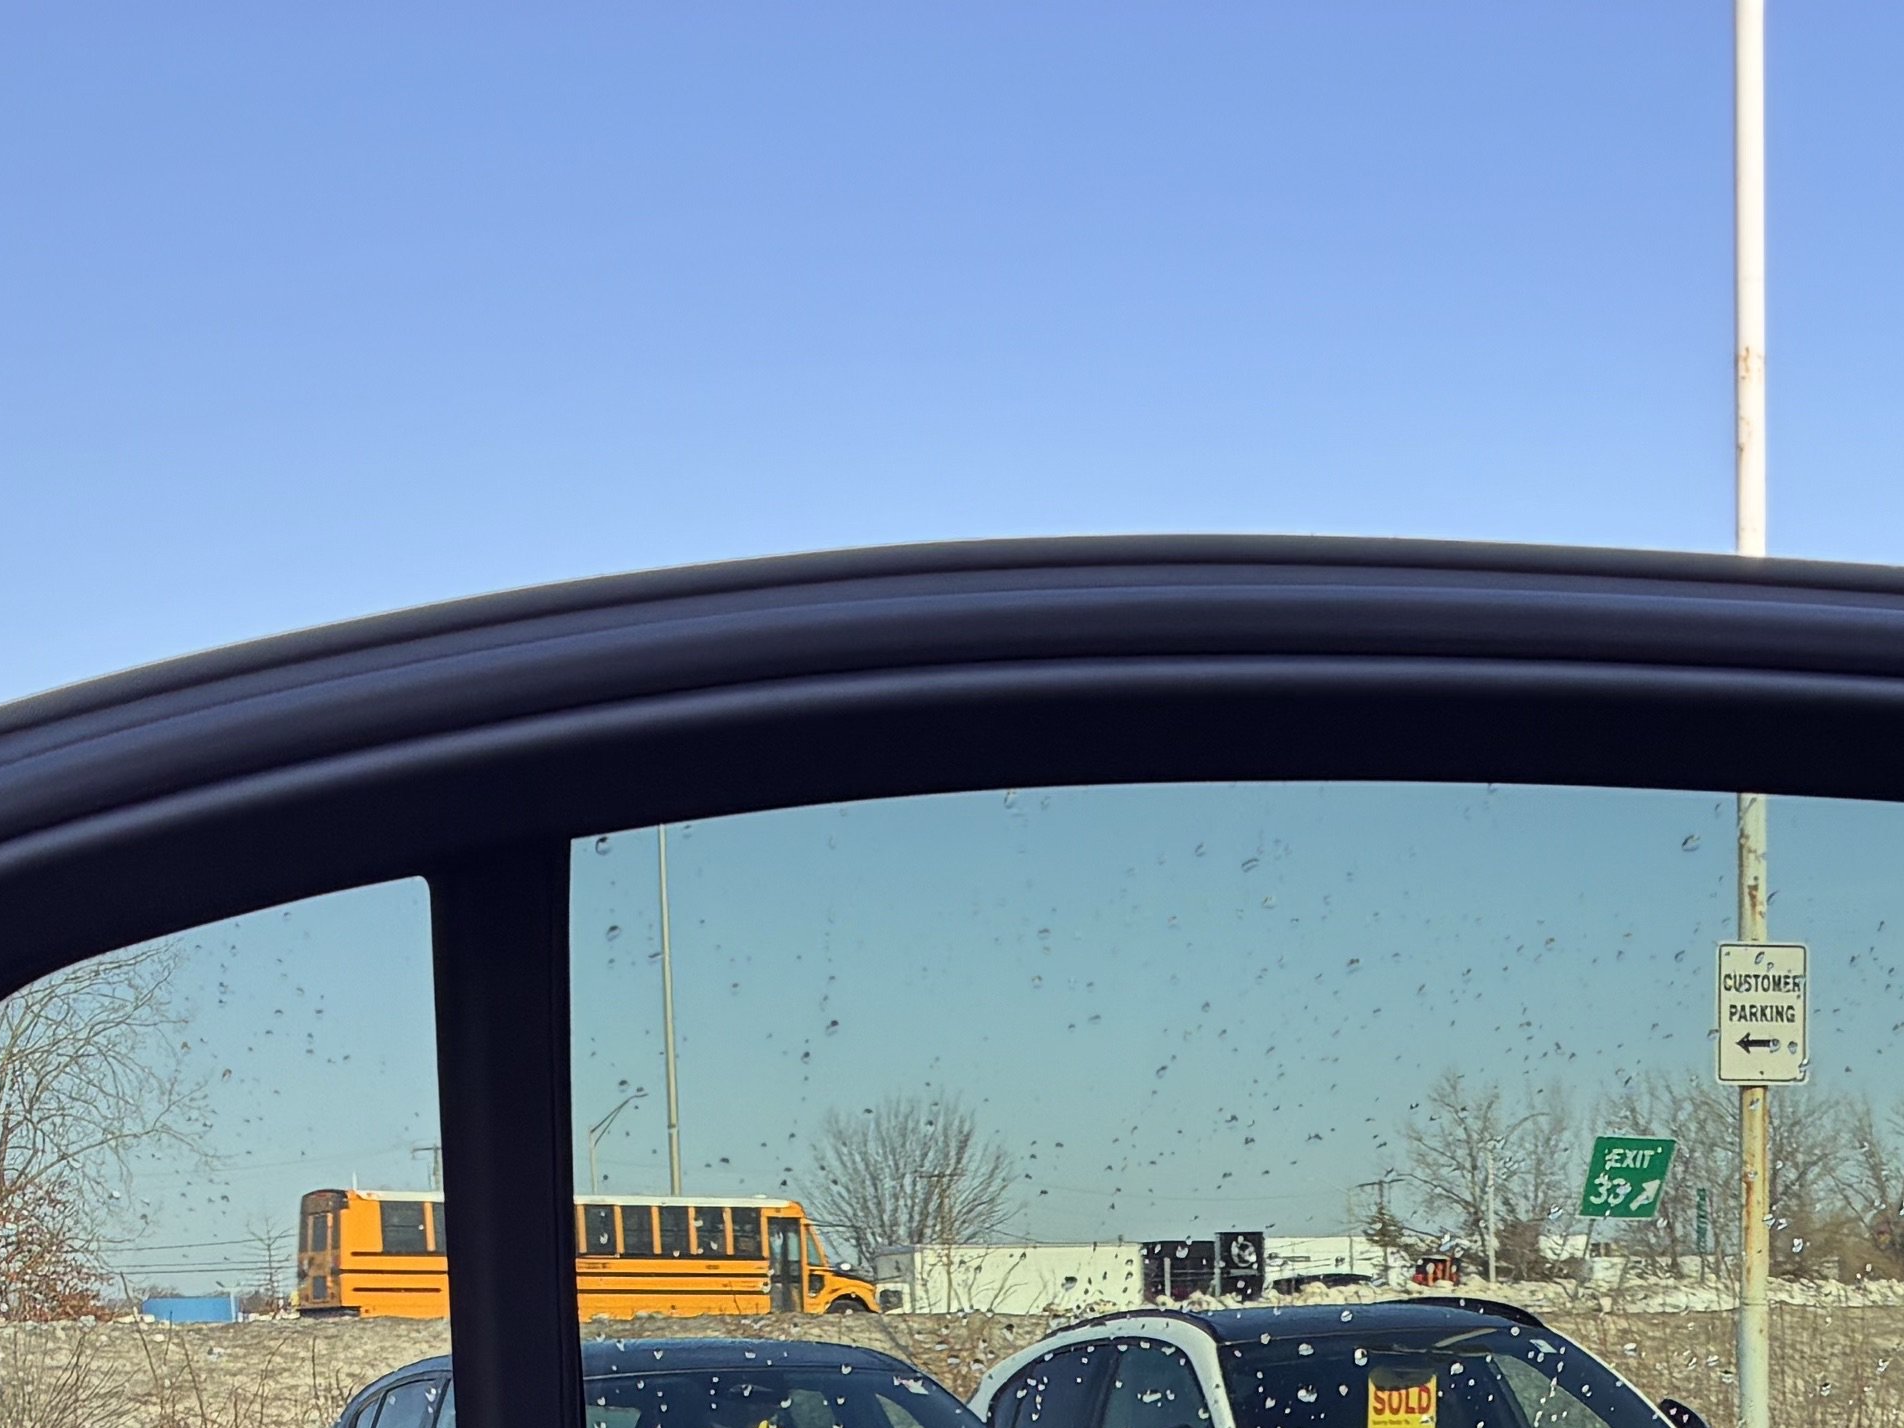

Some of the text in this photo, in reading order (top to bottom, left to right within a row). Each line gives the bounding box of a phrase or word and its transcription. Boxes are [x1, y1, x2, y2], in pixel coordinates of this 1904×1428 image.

[1723, 973, 1801, 993] CUSTOMER
[1728, 1004, 1796, 1023] PARKING
[1605, 1148, 1656, 1169] EXIT
[1373, 1385, 1431, 1415] SOLD
